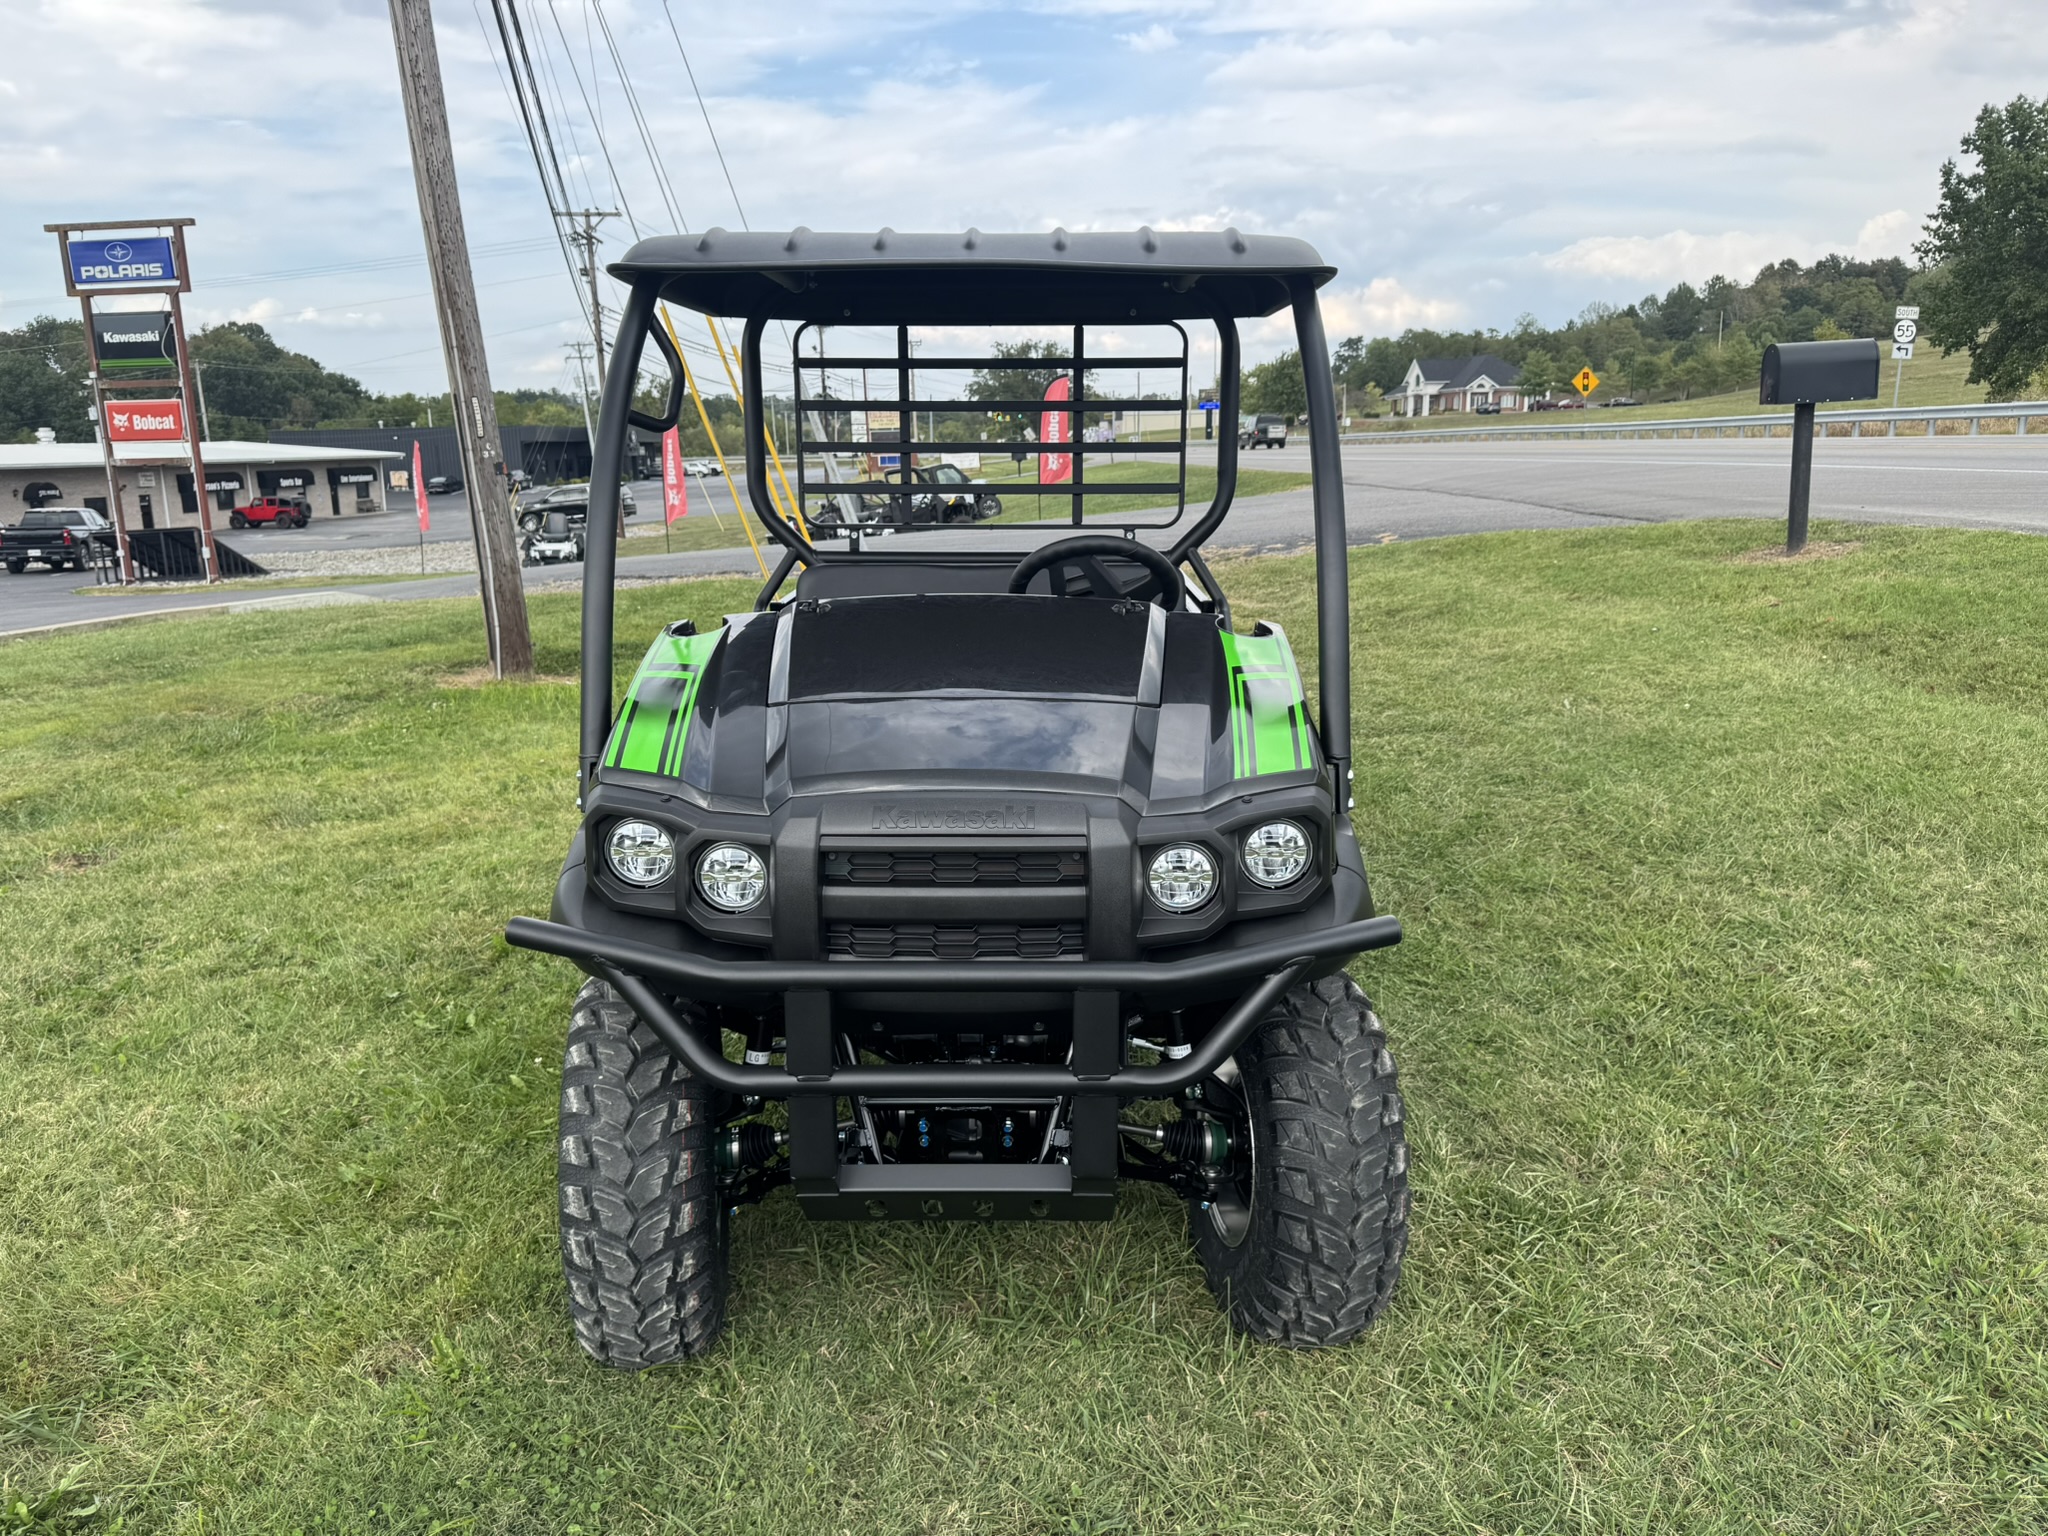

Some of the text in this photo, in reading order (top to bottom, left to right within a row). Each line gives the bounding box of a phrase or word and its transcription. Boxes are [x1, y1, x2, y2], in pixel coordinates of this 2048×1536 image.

[80, 262, 163, 280] POLARIS
[1897, 308, 1918, 317] SOUTH
[103, 330, 160, 343] Kawasaki
[1897, 324, 1914, 338] 55
[132, 414, 175, 431] Bobcat
[871, 805, 1036, 830] Kawasaki
